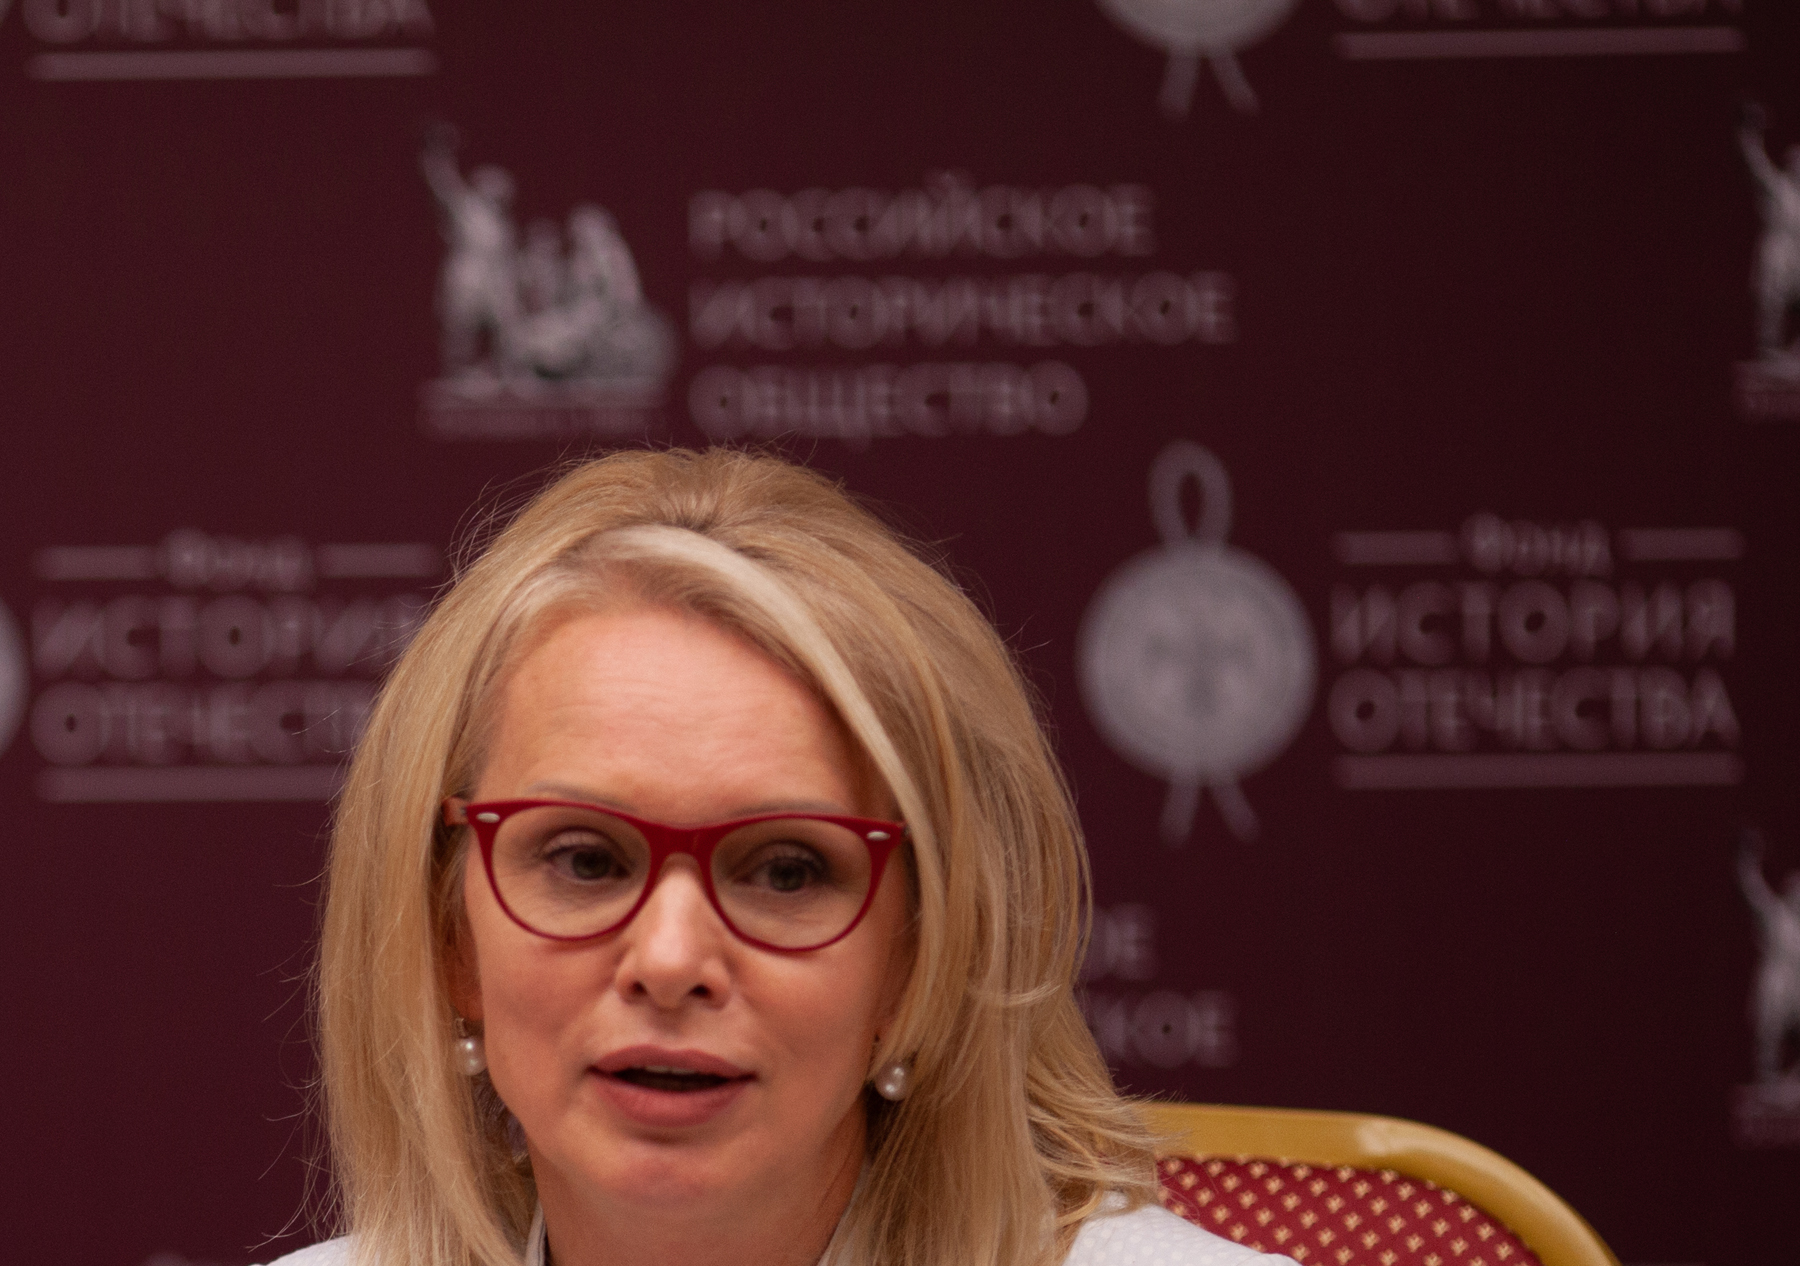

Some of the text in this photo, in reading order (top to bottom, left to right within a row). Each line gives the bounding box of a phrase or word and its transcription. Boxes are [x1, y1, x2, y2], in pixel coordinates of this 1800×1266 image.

[688, 167, 1157, 260] РОССИЙСКОЕ
[688, 270, 1237, 349] ИСТОРИЧЕСКОЕ
[32, 594, 418, 680] ИСТОРИ
[1331, 580, 1736, 664] ИСТОРИЯ
[1329, 667, 1741, 754] ОТЕЧЕСТВА
